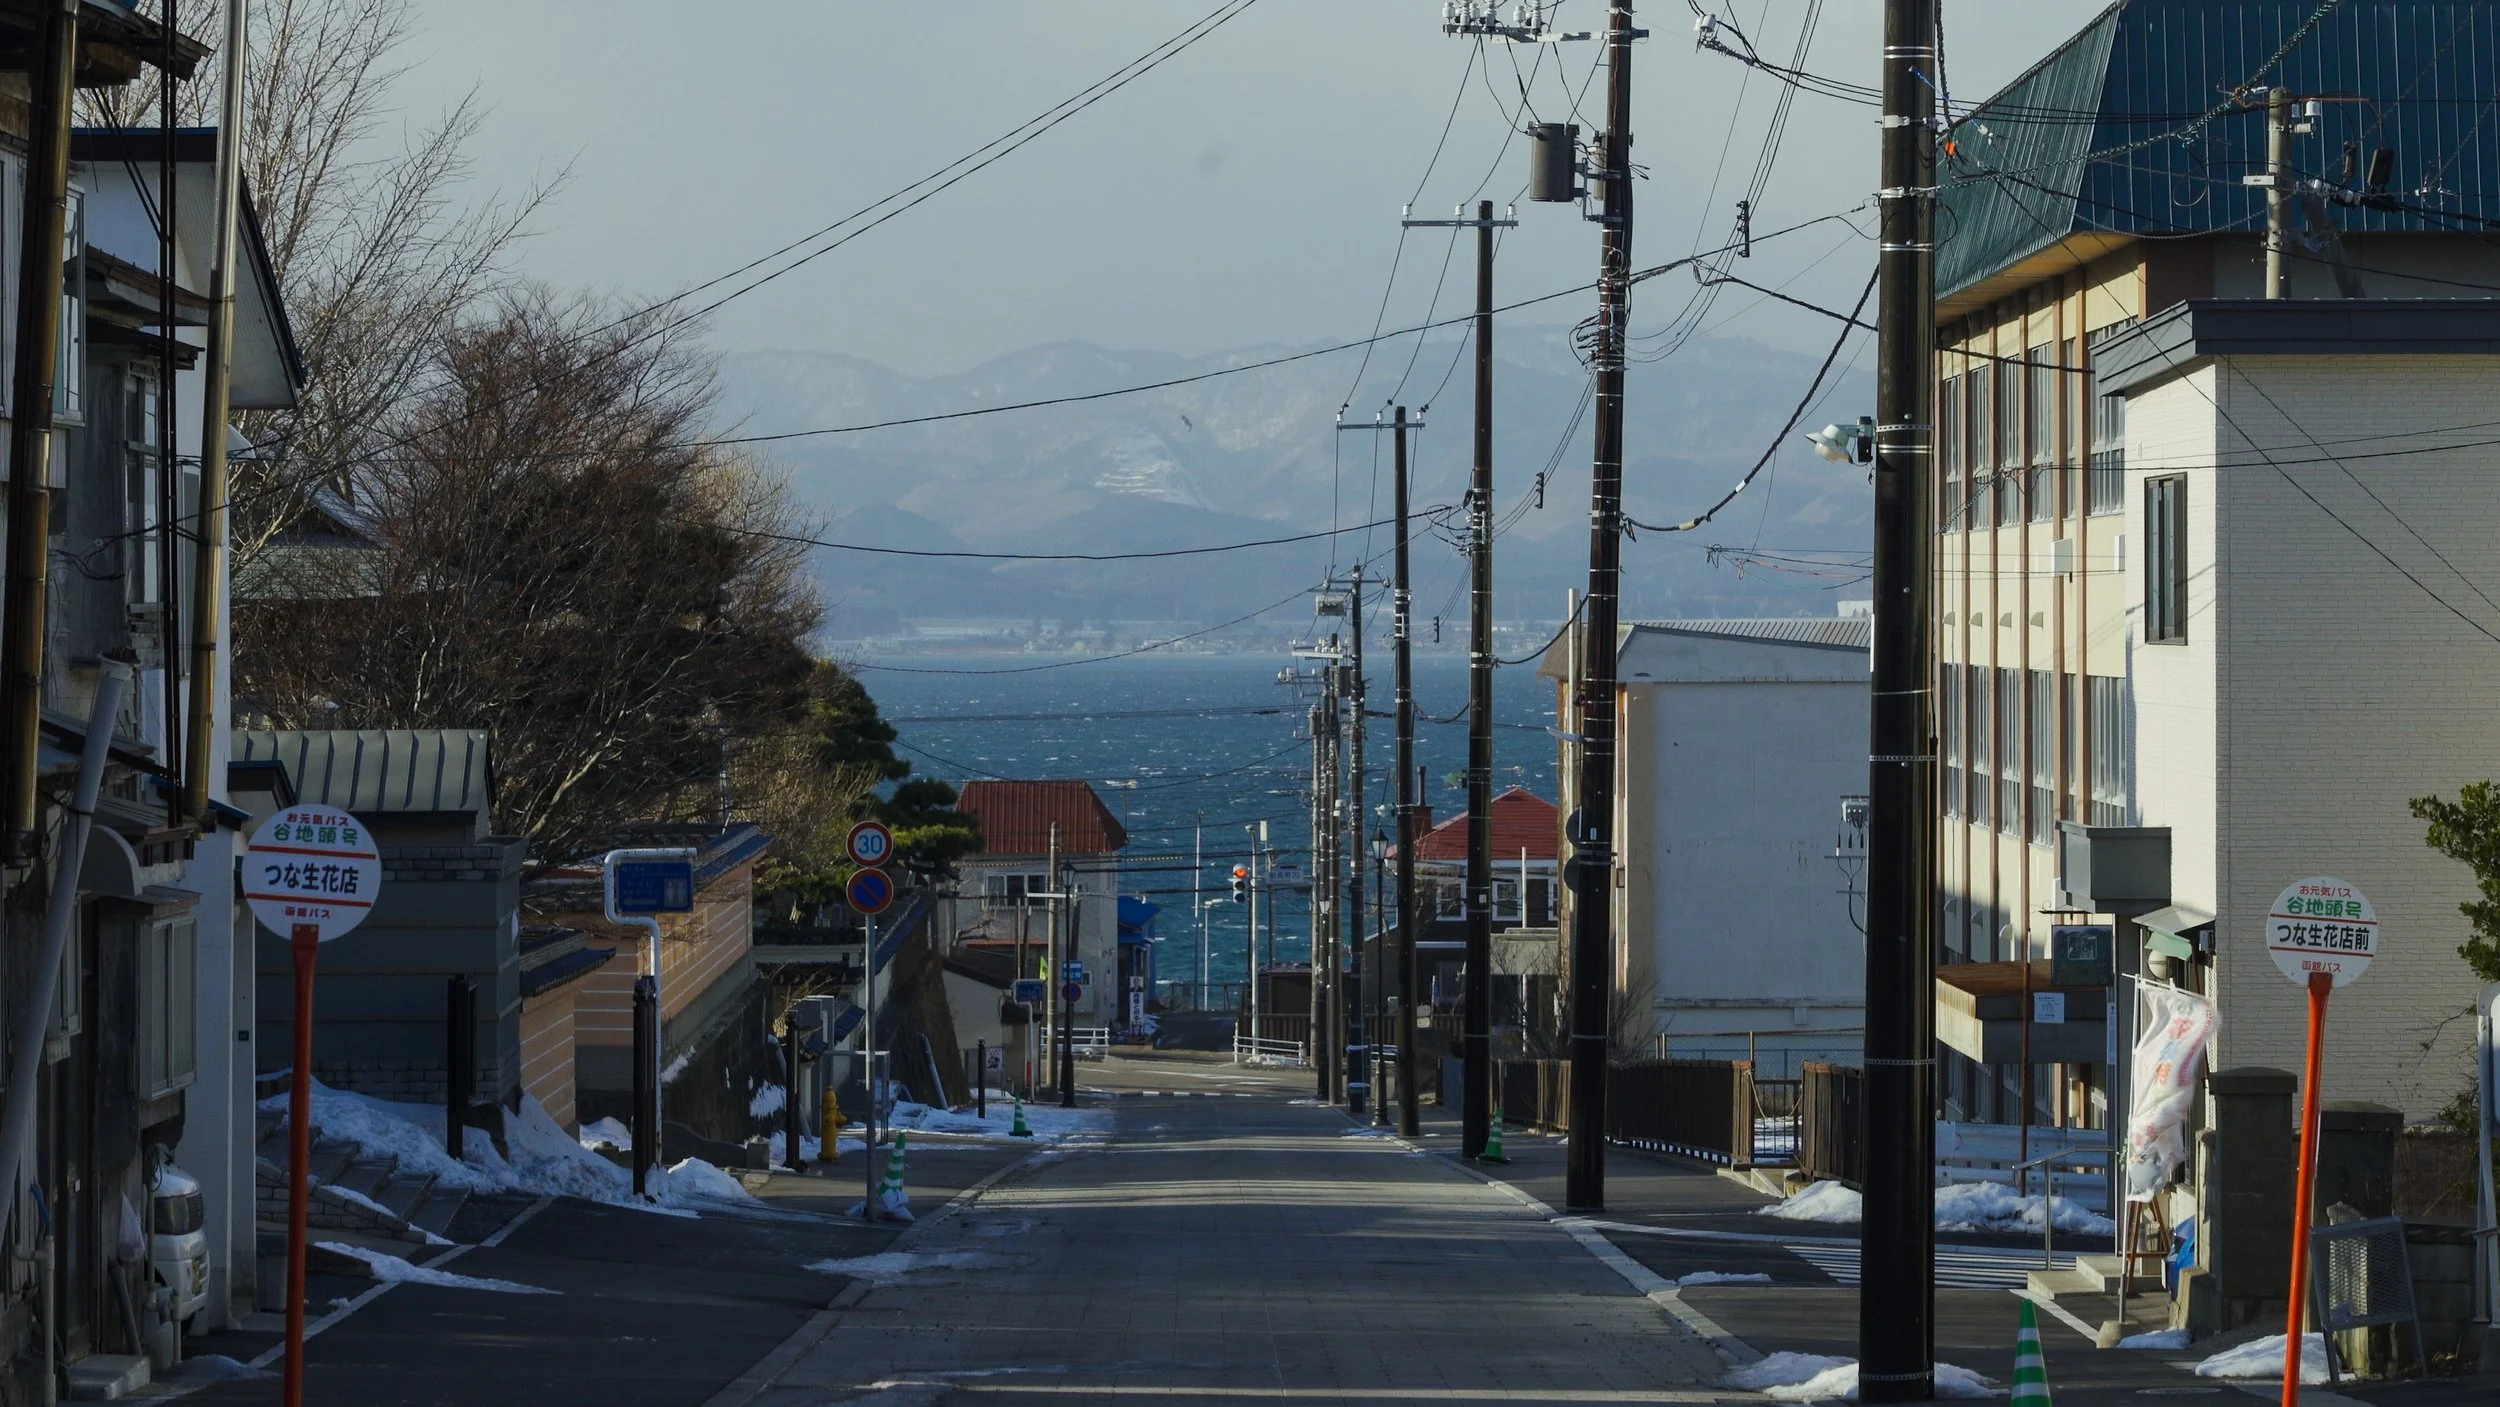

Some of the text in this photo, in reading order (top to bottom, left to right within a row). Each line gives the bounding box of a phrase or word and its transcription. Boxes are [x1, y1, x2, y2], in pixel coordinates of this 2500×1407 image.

[286, 812, 349, 827] お元気バス
[273, 823, 358, 846] 谷地頭号
[857, 835, 883, 854] 30
[264, 862, 359, 895] つな生花店
[2299, 885, 2352, 898] お元気バス
[2287, 896, 2362, 919] 谷地頭号
[2277, 923, 2370, 951] つな生花店前
[2301, 960, 2342, 973] 函館バス
